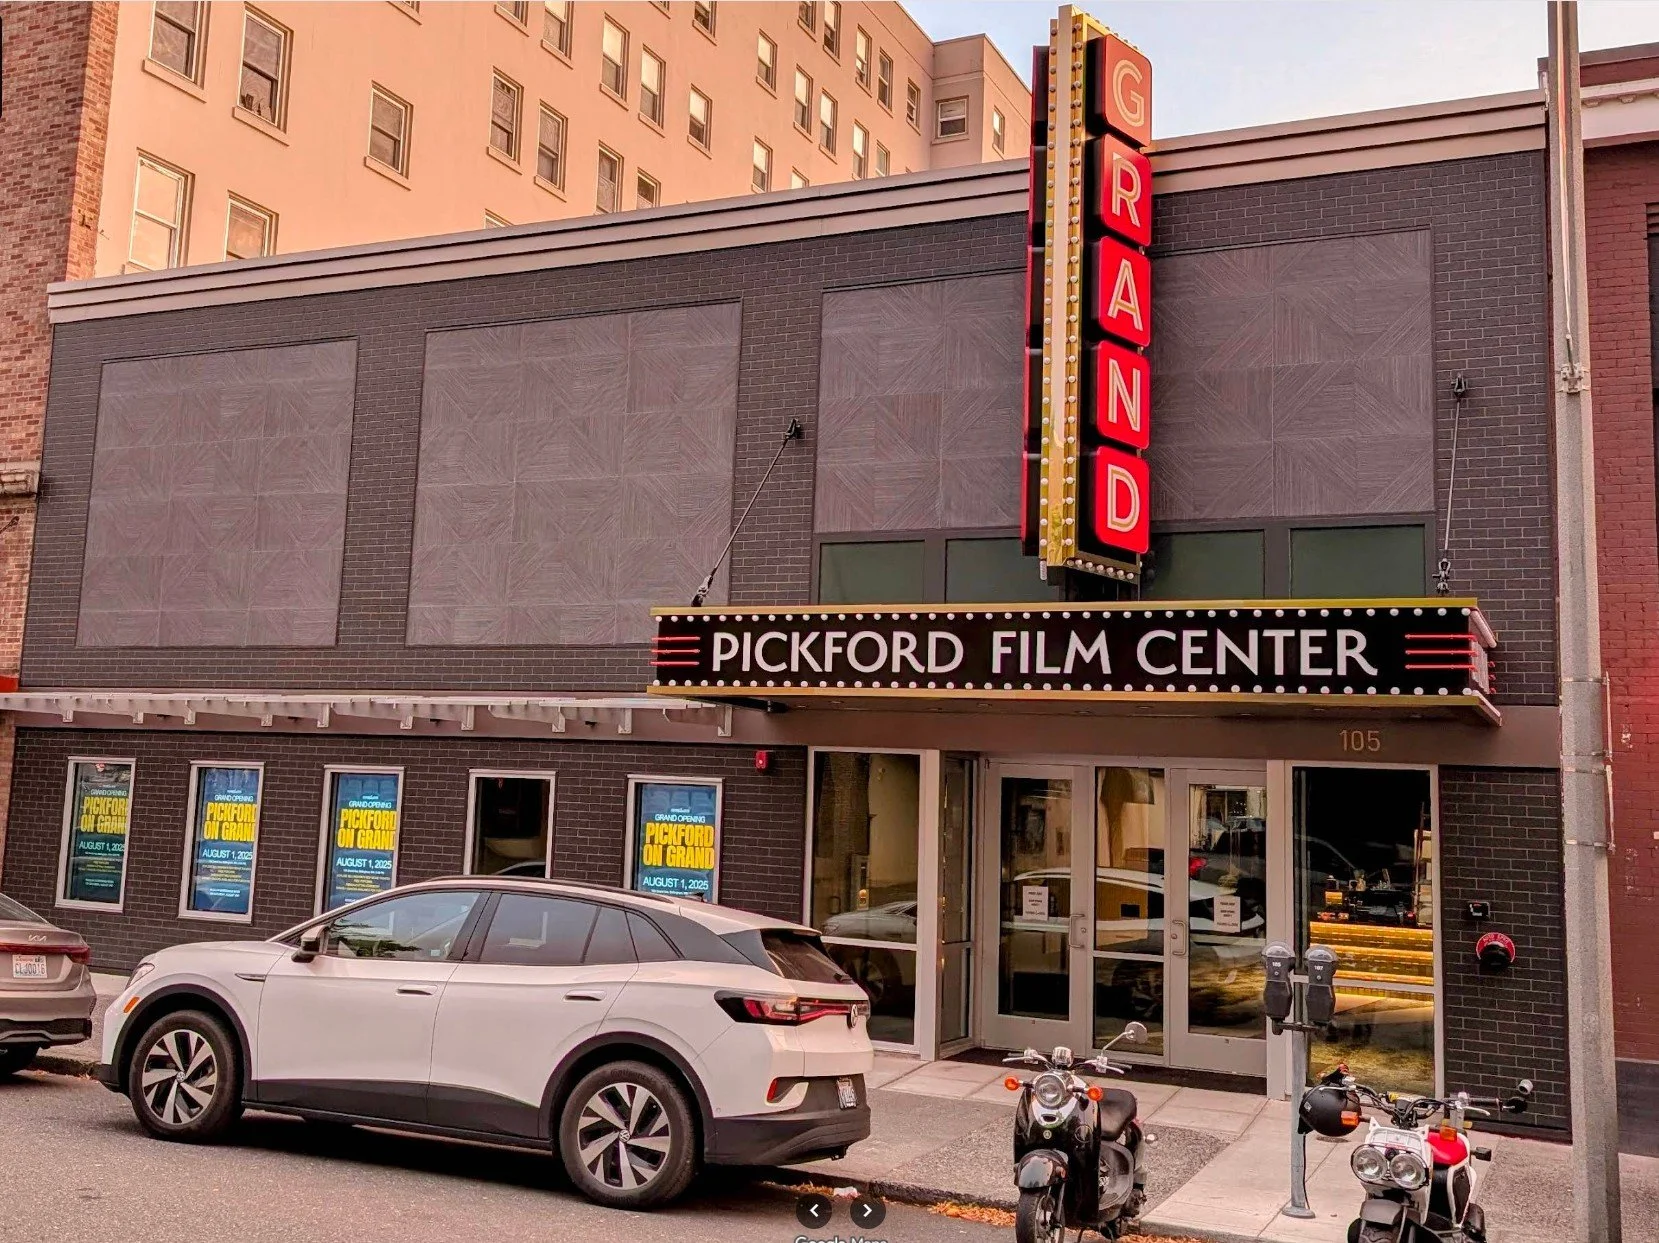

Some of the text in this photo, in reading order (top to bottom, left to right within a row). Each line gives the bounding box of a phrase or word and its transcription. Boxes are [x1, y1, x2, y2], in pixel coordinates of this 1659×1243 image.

[1106, 58, 1145, 533] GRAND
[712, 628, 1378, 677] PICKFORD FILM CENTER
[1340, 730, 1381, 751] 105
[107, 789, 127, 797] OPENING
[214, 794, 231, 802] GRAND
[348, 800, 392, 809] GRAND OPENING
[80, 814, 127, 834] ON GRAN
[340, 808, 397, 830] PICKFORD
[654, 813, 706, 823] GRAND OPENING
[203, 820, 219, 840] ON
[337, 828, 396, 850] ON GRAND
[645, 822, 715, 847] PICKFORD
[79, 841, 105, 850] AUGUST
[202, 848, 231, 858] AUGUST
[237, 851, 253, 860] 2025
[336, 857, 392, 869] AUGUST 1, 2025
[643, 843, 715, 869] ON GRAND
[642, 876, 709, 890] AUGUST 1, 2025
